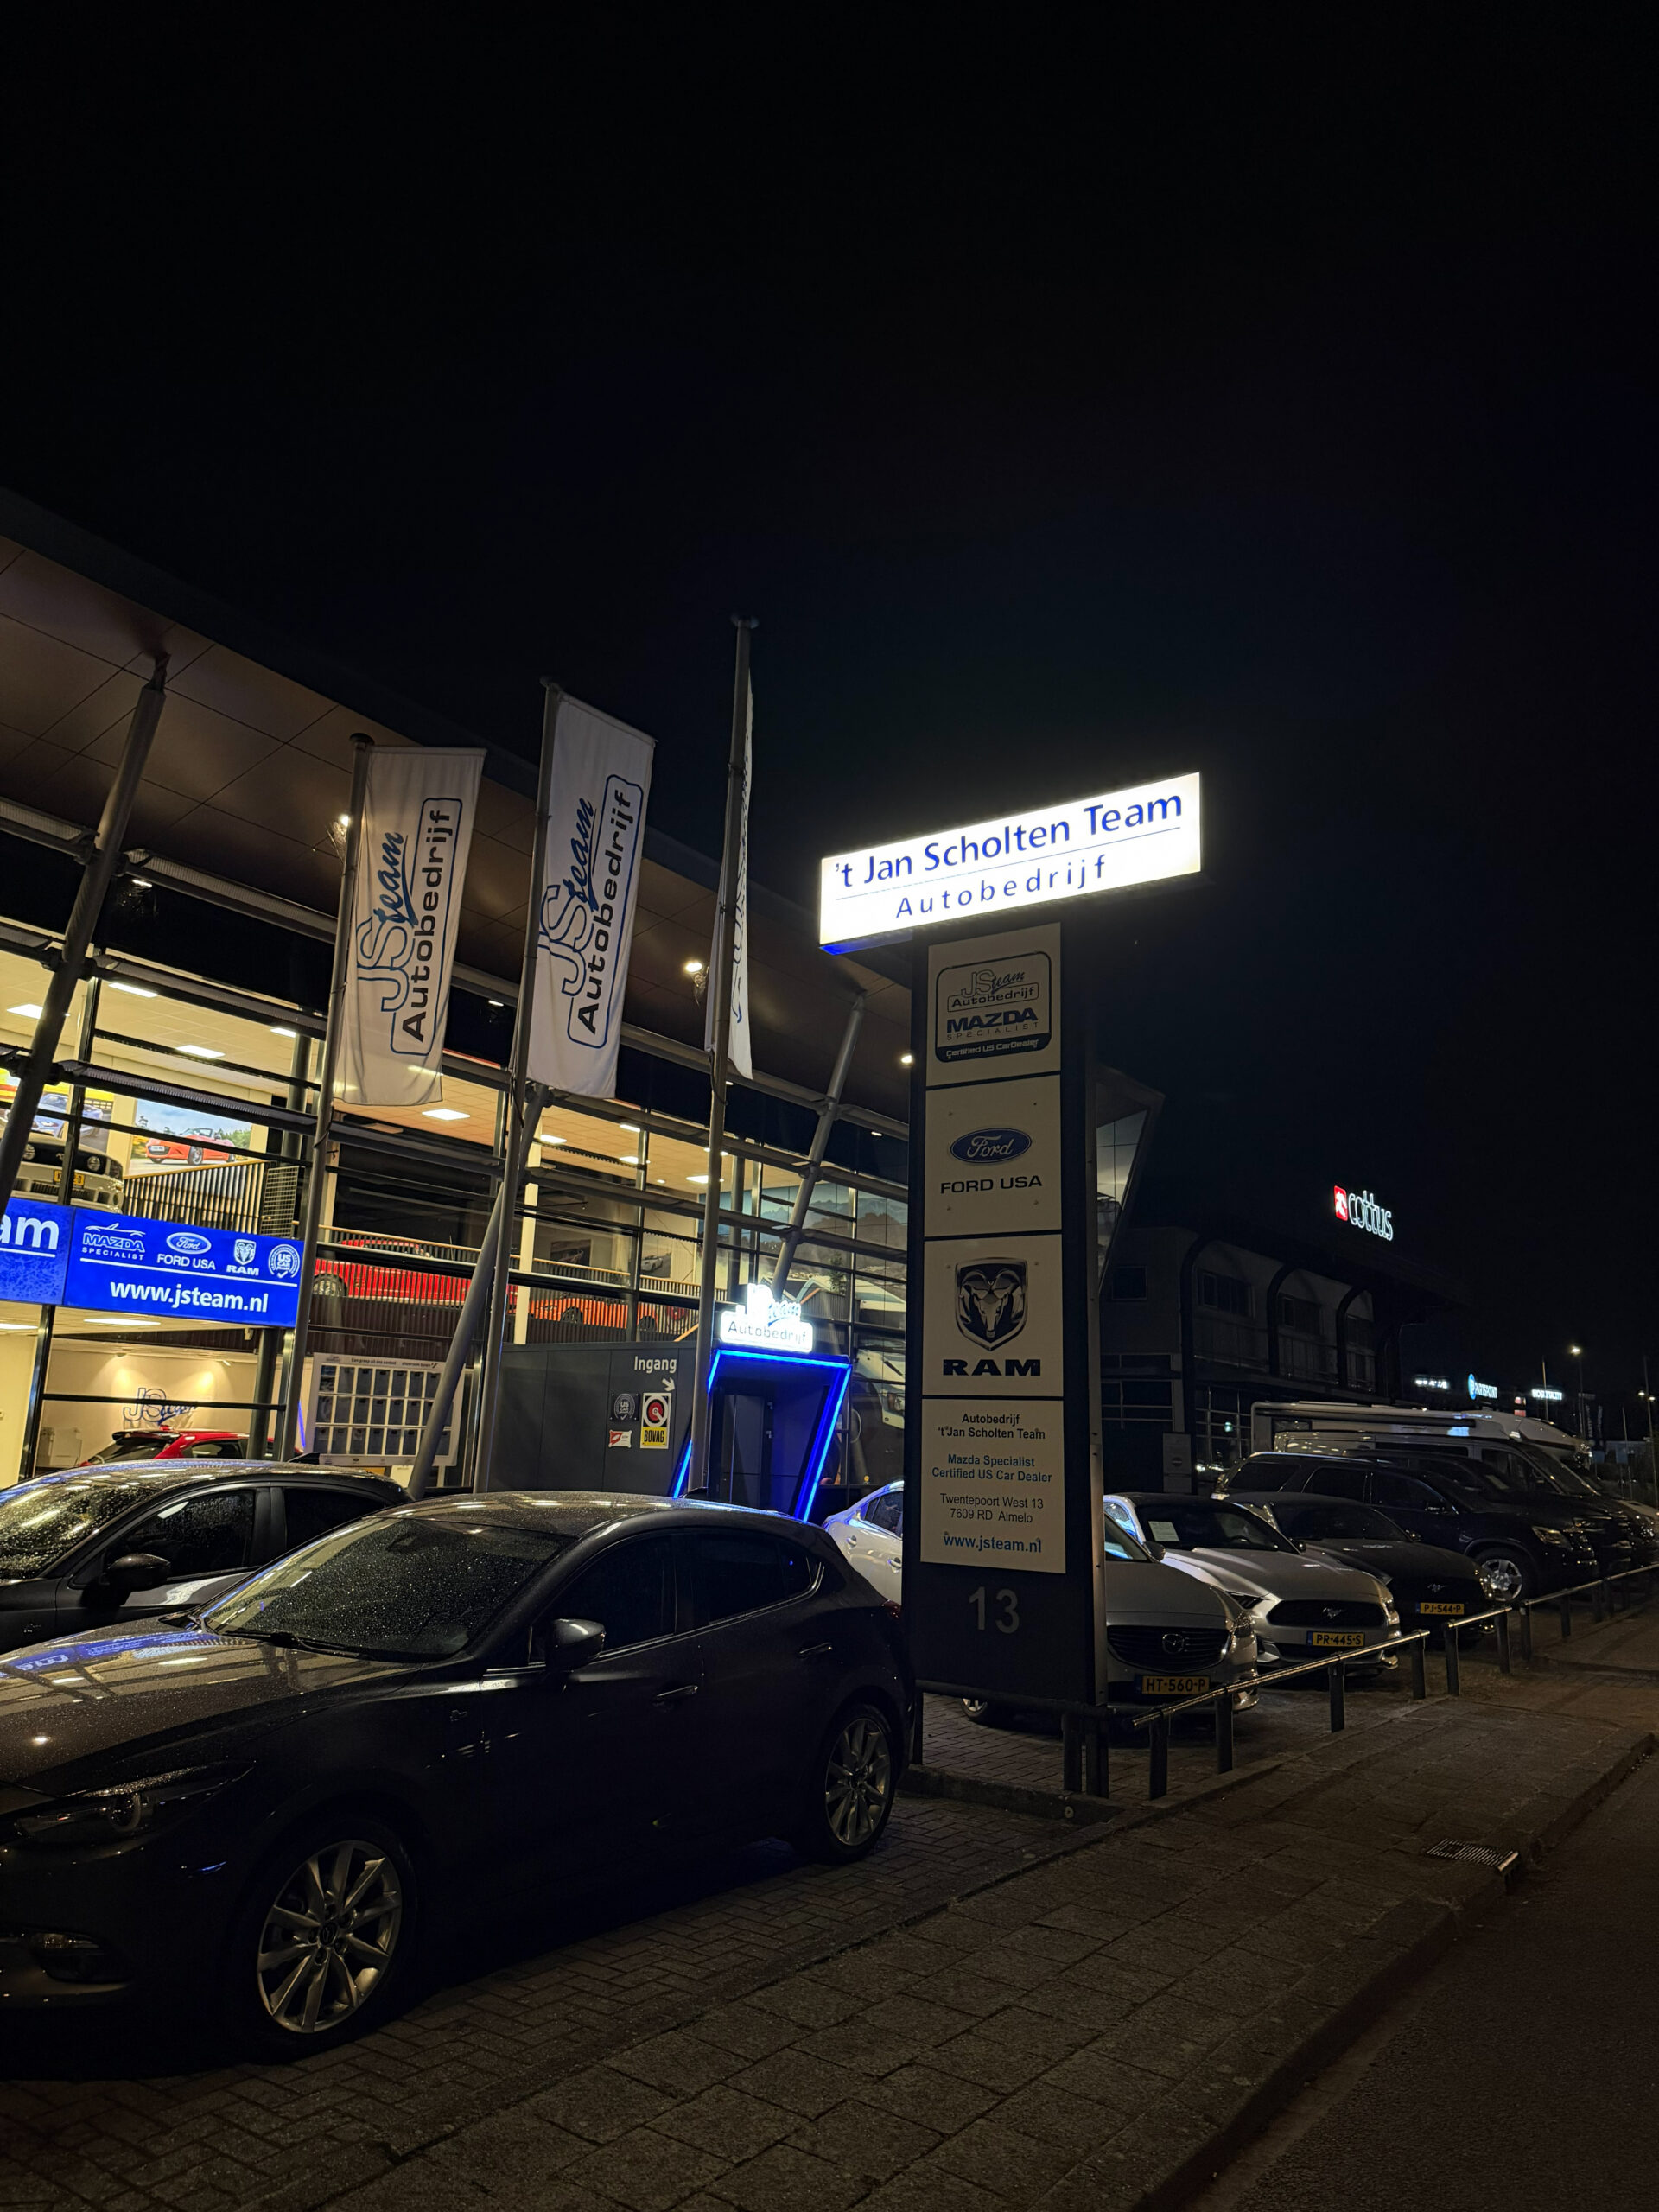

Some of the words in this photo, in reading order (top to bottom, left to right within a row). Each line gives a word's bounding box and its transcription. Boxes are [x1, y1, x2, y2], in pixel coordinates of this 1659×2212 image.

[864, 855, 912, 884] Jan
[925, 820, 1071, 872] Scholten
[1083, 795, 1183, 836] Team
[895, 855, 1107, 918] Autobedrijf
[578, 790, 633, 1035] Autobedrijf
[402, 810, 453, 1042] Autobedrijf
[952, 987, 1034, 1008] Autobedrijf
[947, 1007, 1039, 1033] MAZDA
[946, 1021, 1039, 1041] SPECIALIST
[967, 1135, 1014, 1158] Ford
[941, 1179, 994, 1194] FORD
[1001, 1175, 1043, 1189] USA
[82, 1232, 146, 1253] MAZDA
[176, 1236, 200, 1251] Ford
[82, 1247, 144, 1261] SPECIALIST
[156, 1254, 189, 1267] FORD
[193, 1258, 216, 1270] USA
[226, 1264, 259, 1276] RAM
[110, 1281, 269, 1313] www.jsteam.nl
[634, 1355, 677, 1374] Ingang
[943, 1359, 1041, 1376] RAM
[962, 1414, 1020, 1427] Autobedrijf
[644, 1430, 664, 1443] BOVAG
[947, 1427, 965, 1437] Jan
[969, 1427, 1014, 1438] Scholten
[1017, 1428, 1046, 1439] Team
[948, 1454, 980, 1465] Mazda
[983, 1455, 1034, 1467] Specialist
[932, 1467, 975, 1478] Certified
[978, 1470, 993, 1479] US
[996, 1470, 1014, 1481] Car
[1018, 1471, 1052, 1482] Dealer
[940, 1493, 1000, 1507] Twentepoort
[1002, 1497, 1028, 1508] West
[1032, 1498, 1044, 1510] 13
[950, 1508, 974, 1519] 7609
[977, 1510, 993, 1520] RD
[998, 1511, 1033, 1522] Almelo
[944, 1535, 1042, 1553] www.jsteam.nl
[968, 1586, 1020, 1635] 13
[1424, 1604, 1461, 1613] PJ-544-P
[1316, 1634, 1362, 1645] PR-445-S
[1147, 1678, 1205, 1692] HT-560-P
